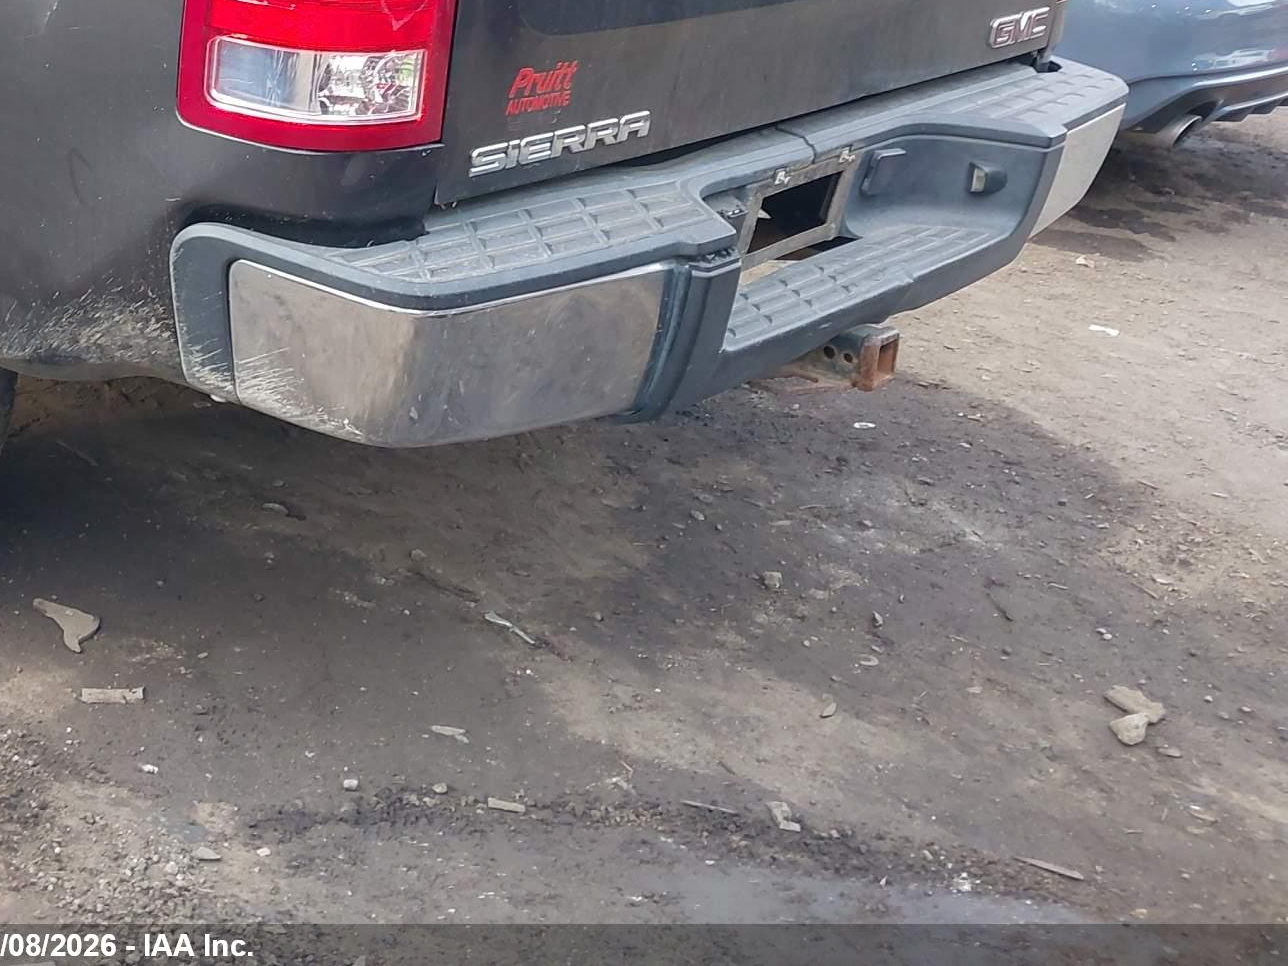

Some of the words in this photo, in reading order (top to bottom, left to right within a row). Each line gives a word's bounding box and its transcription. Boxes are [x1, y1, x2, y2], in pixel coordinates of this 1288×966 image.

[990, 7, 1050, 48] GMC
[508, 60, 579, 99] Pruitt
[505, 90, 571, 116] AUTOMOTIVE
[469, 110, 651, 178] SIERRA
